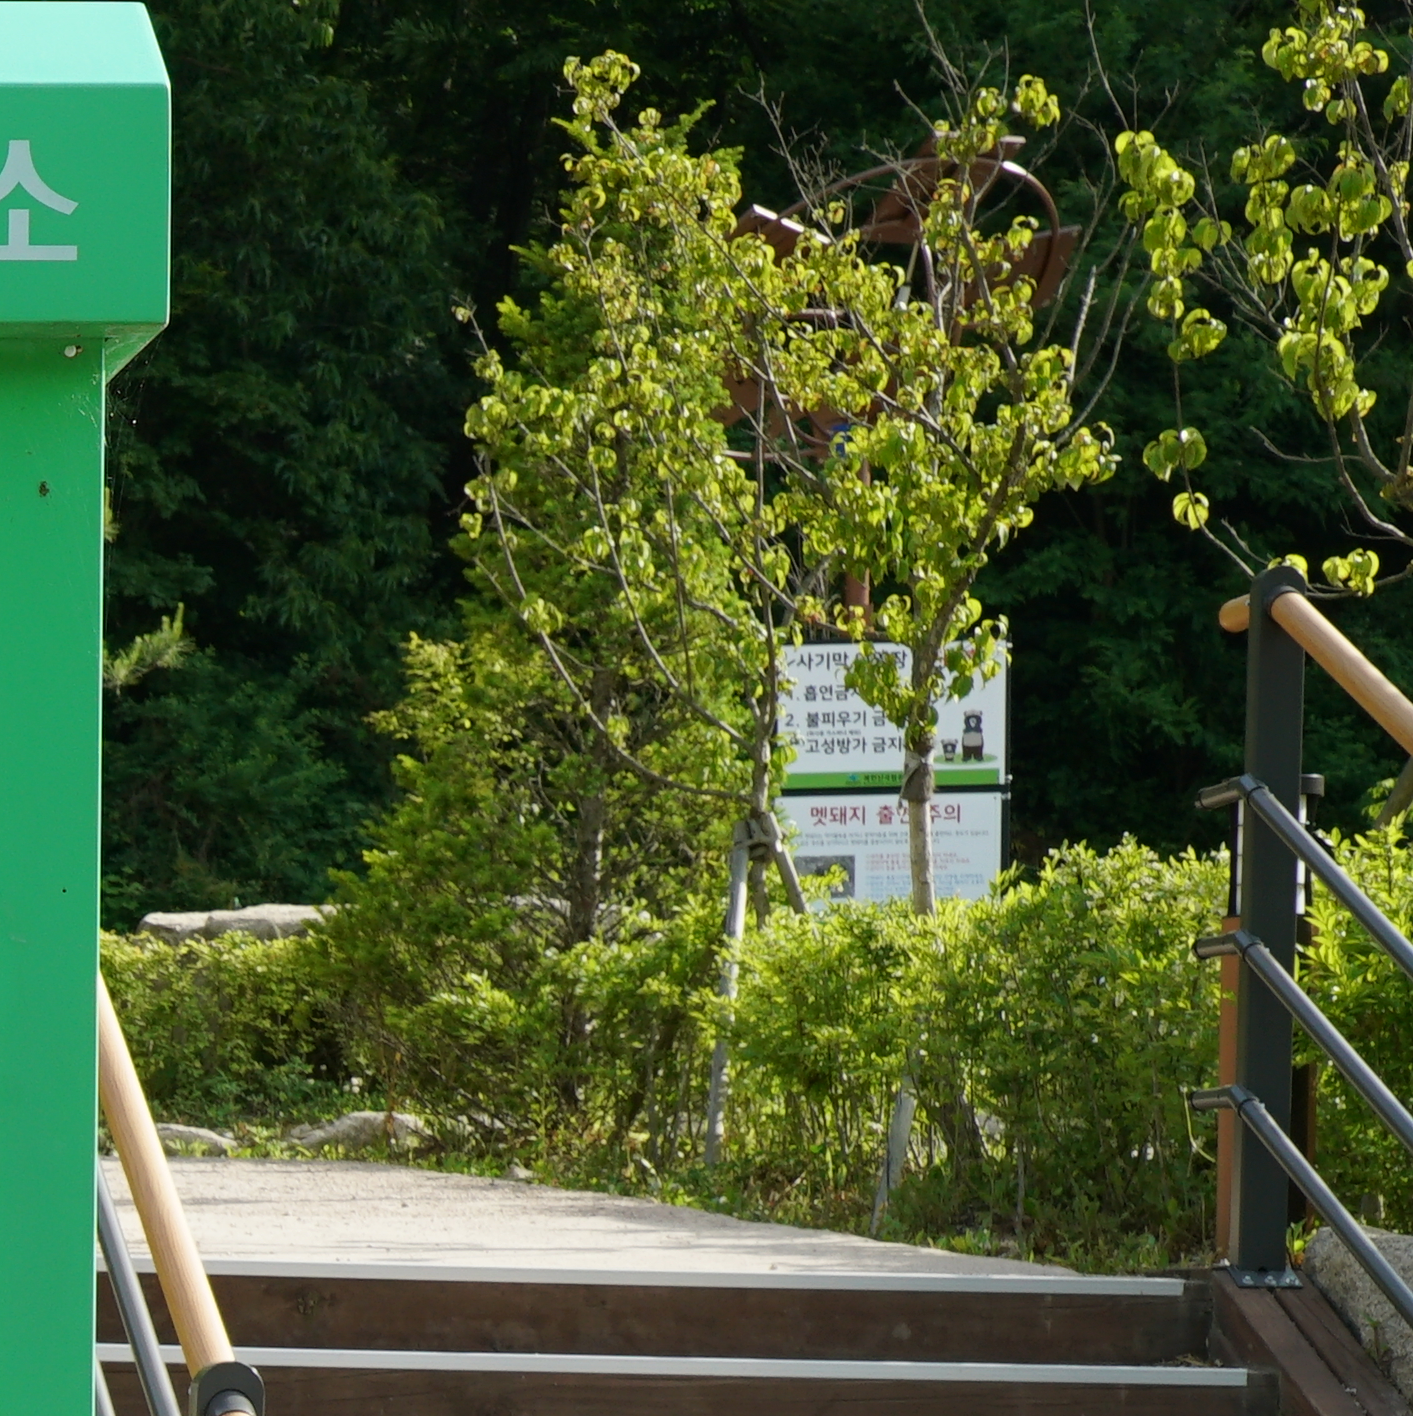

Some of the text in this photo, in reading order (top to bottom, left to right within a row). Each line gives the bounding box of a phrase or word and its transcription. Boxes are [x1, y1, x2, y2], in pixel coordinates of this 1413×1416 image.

[806, 711, 867, 728] 불피우기
[805, 737, 903, 755] 고성방가 금지
[811, 805, 866, 826] 멧돼지
